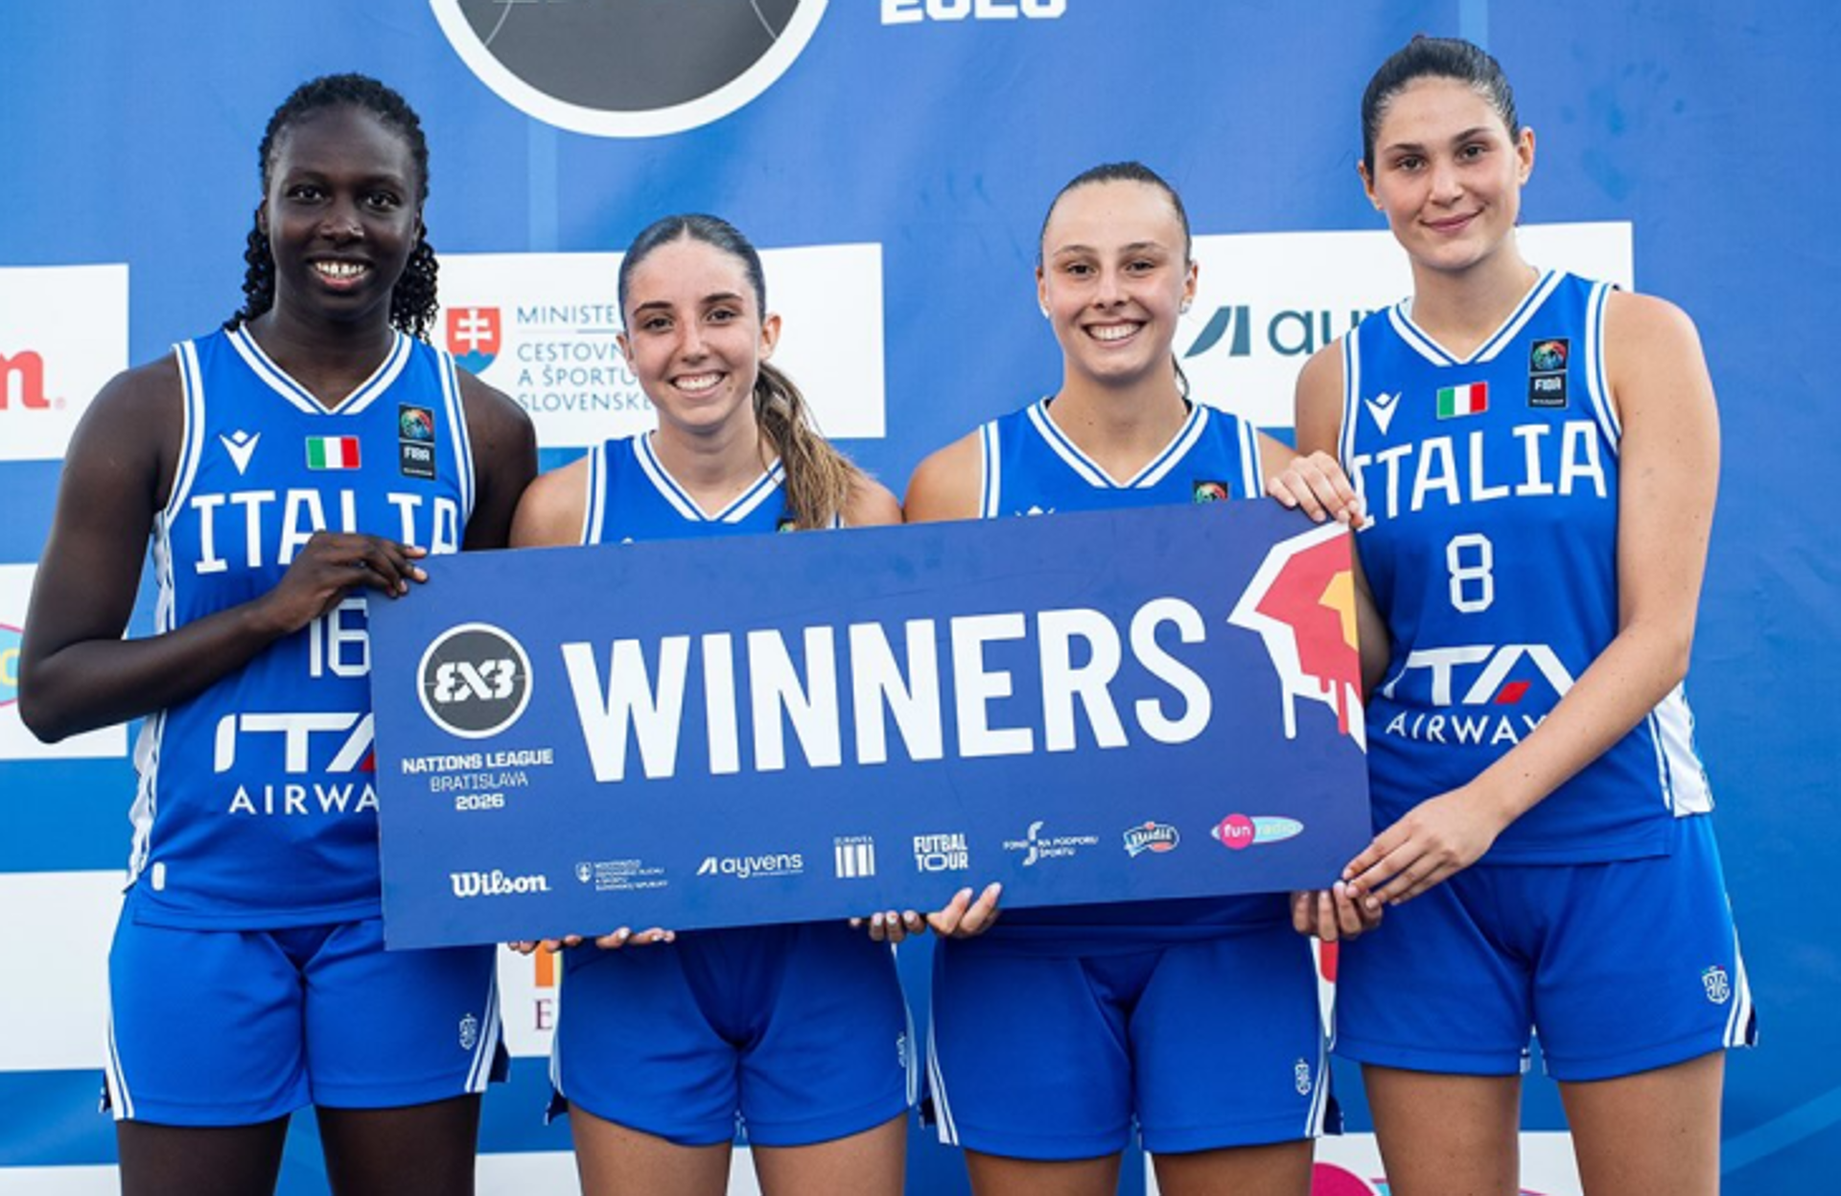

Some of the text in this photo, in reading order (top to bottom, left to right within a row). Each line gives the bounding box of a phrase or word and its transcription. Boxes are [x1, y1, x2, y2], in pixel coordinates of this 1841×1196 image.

[516, 304, 615, 324] MINISTE
[517, 363, 637, 387] A ŠPORTU
[1350, 420, 1607, 532] ITALIA
[1446, 533, 1494, 613] 8
[310, 598, 371, 678] 16
[561, 597, 1212, 782] WINNERS
[402, 749, 554, 774] NATIONS LEAGUE
[431, 771, 528, 792] BRATISLAVA
[455, 793, 505, 810] 2026
[1223, 823, 1251, 838] fun
[913, 834, 968, 853] FUTBAL
[720, 854, 803, 878] ayvens
[915, 851, 968, 873] TOUR
[450, 870, 548, 898] Wilson
